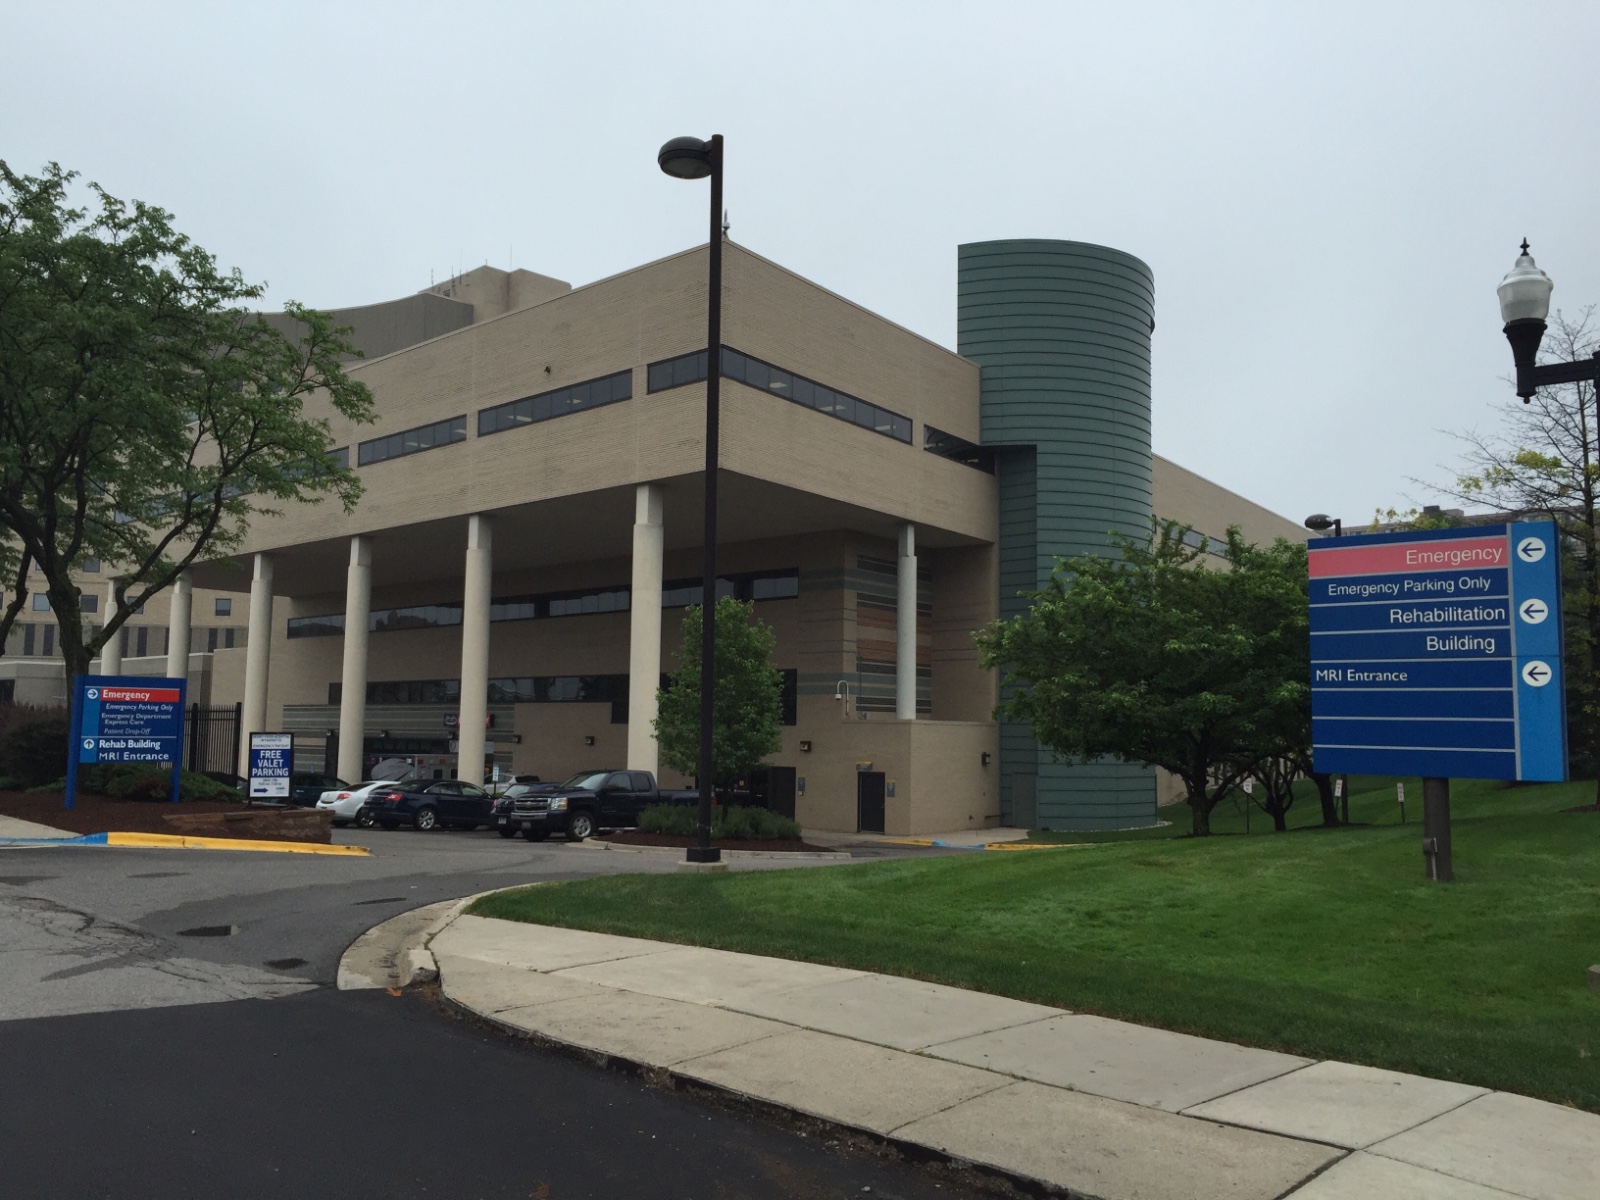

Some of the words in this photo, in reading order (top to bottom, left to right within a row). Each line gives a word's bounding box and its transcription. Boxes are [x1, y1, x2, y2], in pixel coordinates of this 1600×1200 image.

[1406, 547, 1503, 565] Emergency
[1328, 581, 1400, 597] Emergency
[1404, 578, 1455, 593] Parking
[1458, 576, 1491, 591] Only
[1389, 606, 1506, 624] Rehabilitation
[1426, 635, 1495, 653] Building
[1316, 669, 1342, 682] MRI
[1347, 669, 1408, 682] Entrance
[102, 689, 150, 701] Emergency
[106, 703, 137, 711] Emergency
[138, 704, 159, 712] Parking
[160, 704, 173, 712] Only
[99, 740, 126, 748] Rehab
[127, 740, 161, 750] Building
[99, 752, 120, 760] MRI
[123, 752, 169, 760] Entrance
[260, 750, 281, 758] FREE
[258, 759, 284, 767] VALET
[252, 768, 289, 776] PARKING
